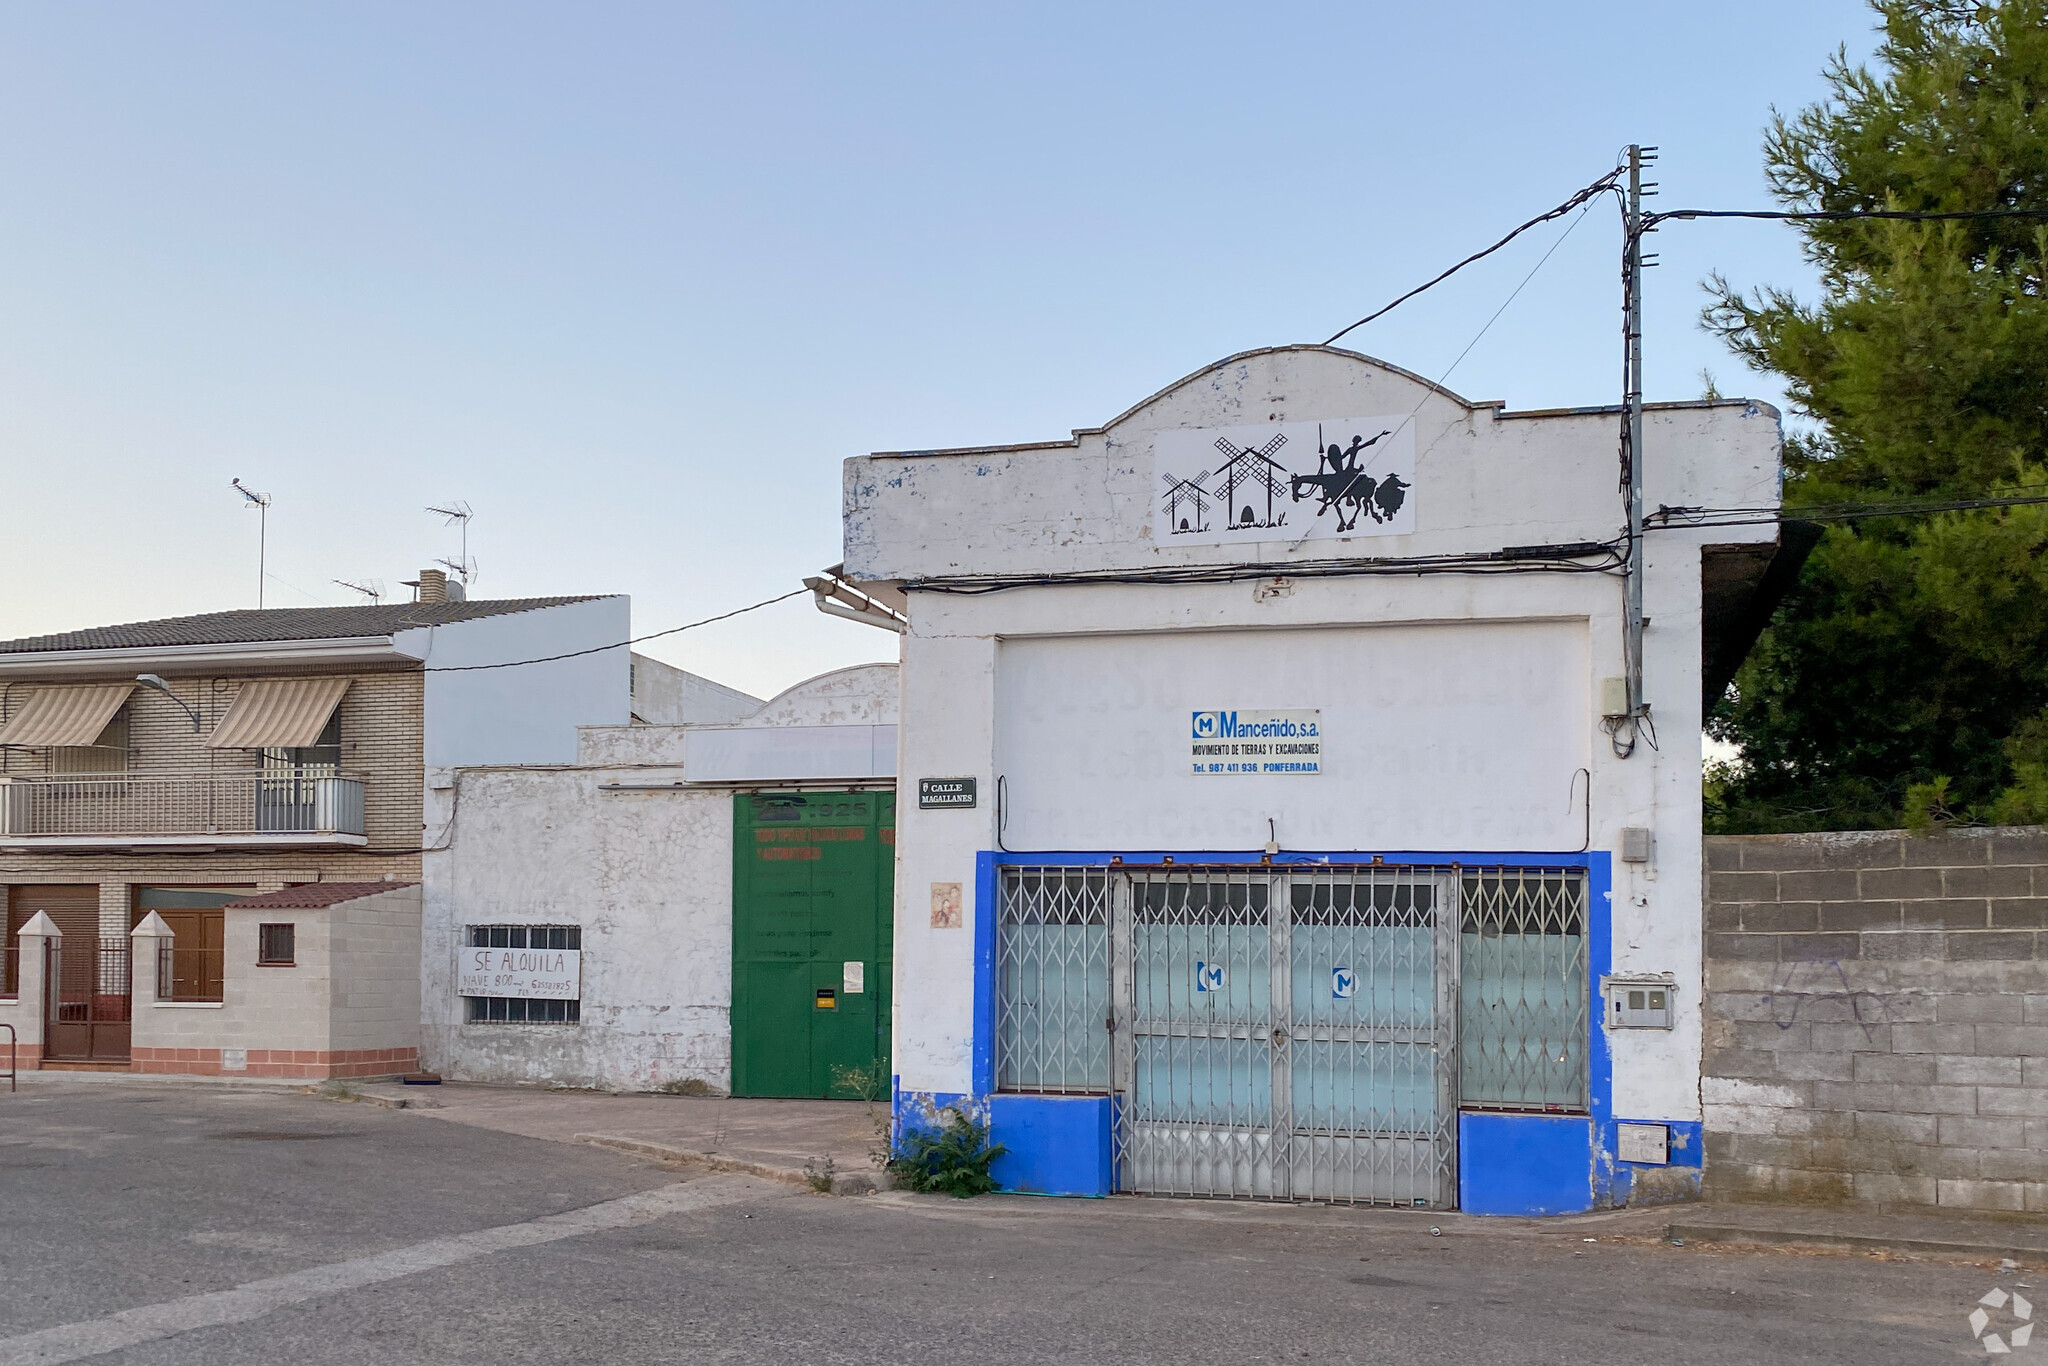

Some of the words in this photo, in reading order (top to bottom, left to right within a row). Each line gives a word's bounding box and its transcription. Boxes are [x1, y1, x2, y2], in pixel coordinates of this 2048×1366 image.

[1192, 744, 1229, 755] MOVIMIENTO
[1231, 744, 1239, 755] DE
[1241, 744, 1267, 755] TIERRAS
[1269, 744, 1273, 755] Y
[1275, 743, 1319, 754] EXCAVACIONES
[1193, 763, 1206, 772] Tel.
[1208, 763, 1224, 772] 987
[1227, 763, 1239, 772] 411
[1241, 763, 1258, 772] 936
[1263, 762, 1319, 772] PONFERRADA
[930, 784, 963, 793] CALLE
[921, 794, 973, 804] MAGALLANES
[474, 950, 493, 971] SE
[500, 951, 565, 973] ALQUILA
[463, 974, 489, 987] NAVE
